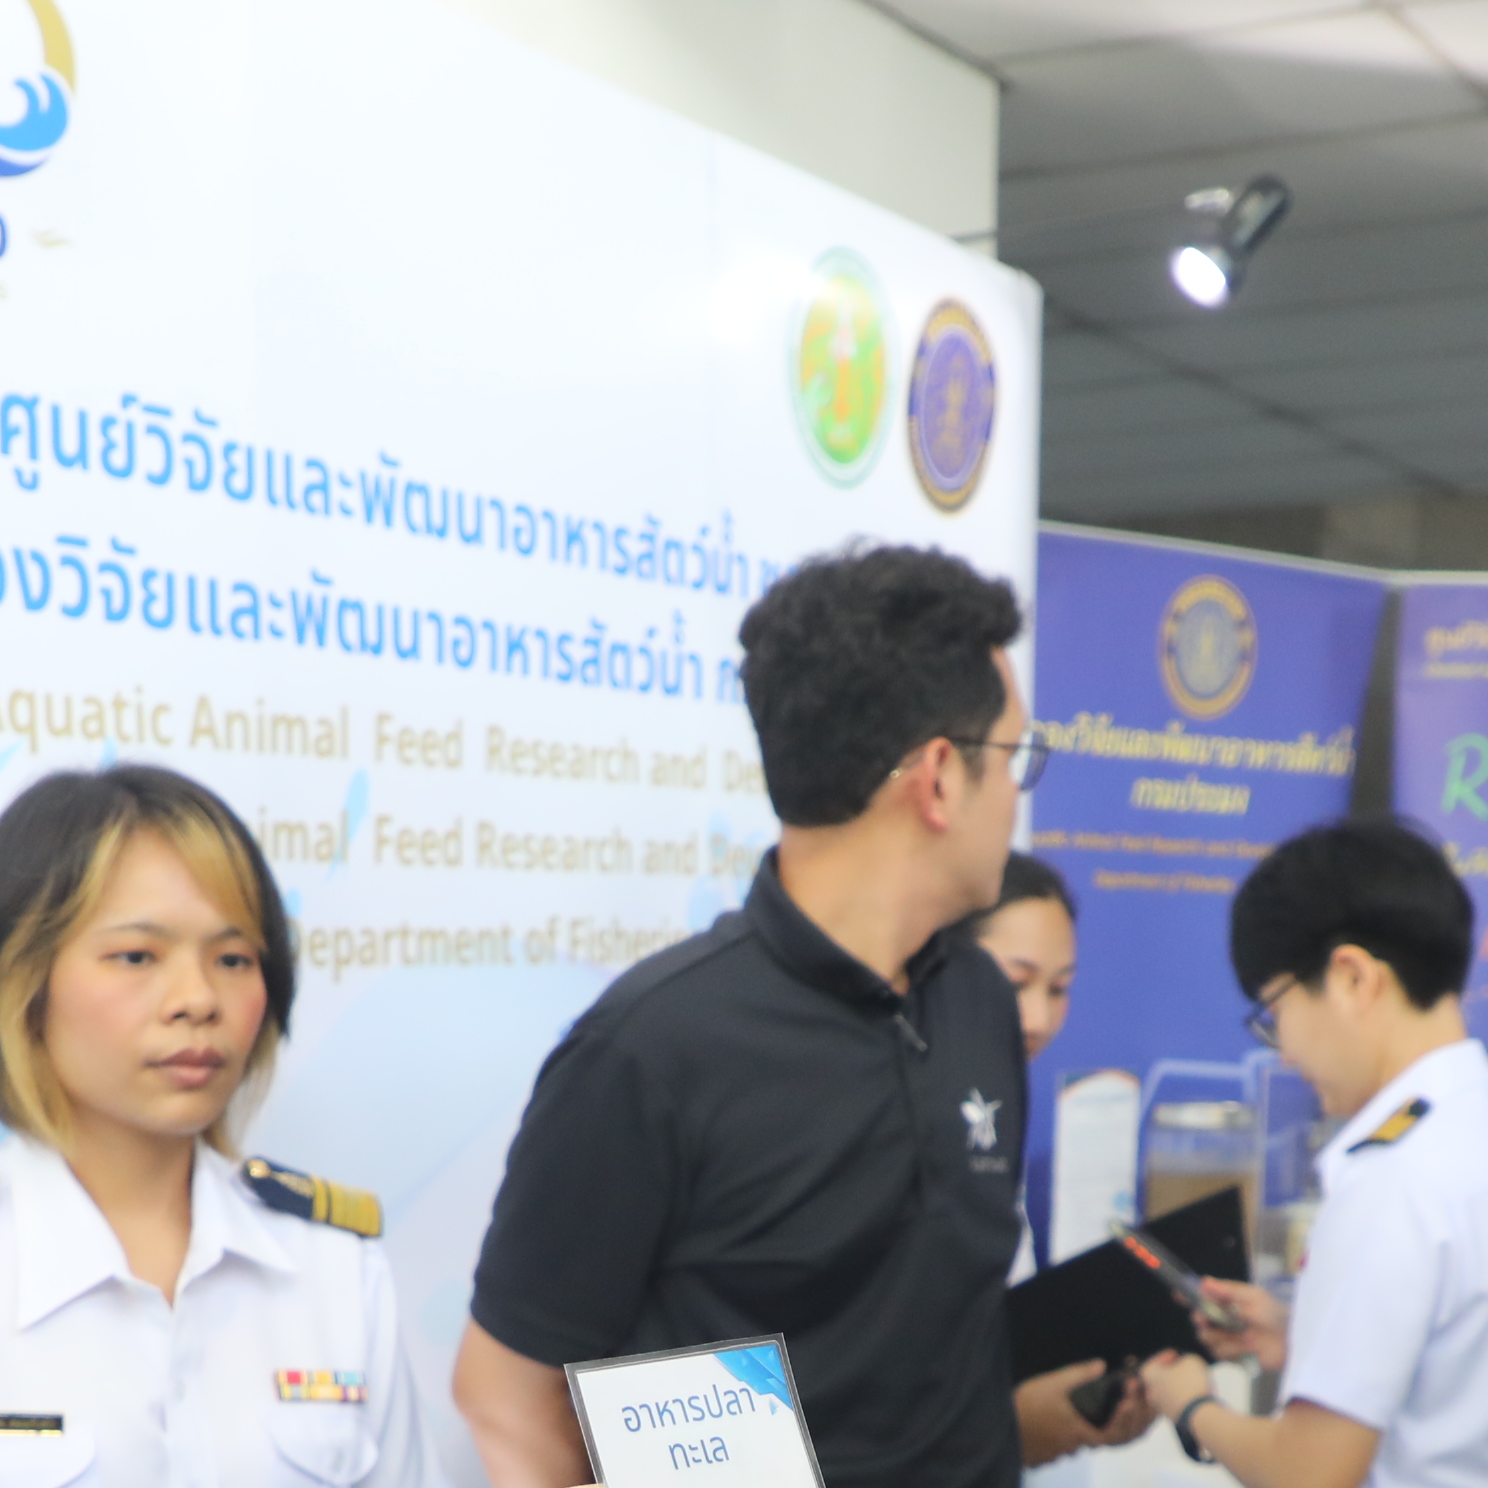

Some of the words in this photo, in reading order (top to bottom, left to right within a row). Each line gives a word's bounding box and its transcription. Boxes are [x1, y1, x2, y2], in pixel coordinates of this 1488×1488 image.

[189, 692, 350, 761] Animal
[374, 711, 464, 769] Feed
[485, 724, 640, 784] Research
[650, 745, 708, 791] and
[722, 747, 768, 793] De
[257, 804, 350, 865] imal
[374, 814, 464, 867] Feed
[476, 818, 632, 874] Research
[642, 829, 698, 876] and
[524, 914, 559, 963] of
[621, 1384, 756, 1433] อาหารปลา
[668, 1435, 730, 1470] ทะเล
